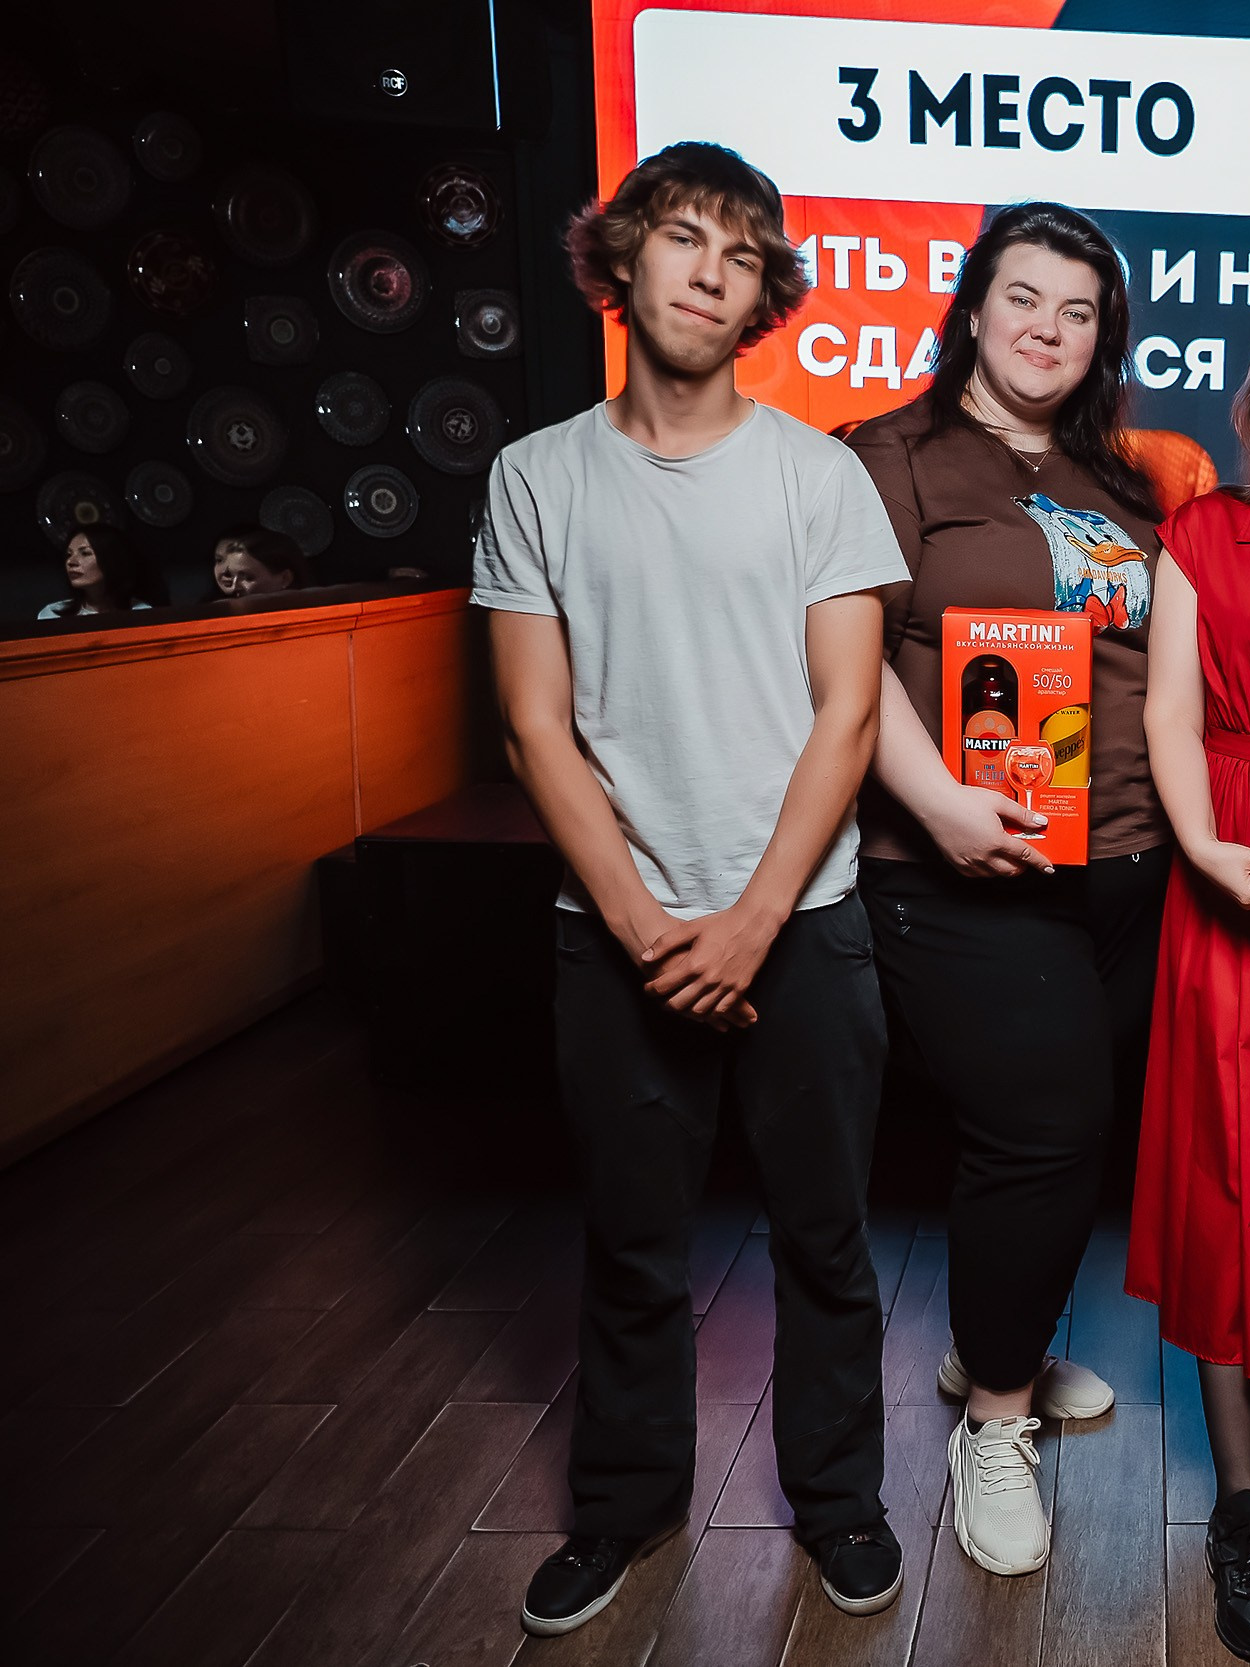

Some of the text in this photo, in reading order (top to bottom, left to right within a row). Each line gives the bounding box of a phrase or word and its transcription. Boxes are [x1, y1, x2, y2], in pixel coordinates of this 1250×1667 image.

[382, 76, 405, 90] RCF
[836, 66, 1195, 157] 3 МЕСТО
[1150, 248, 1196, 303] И
[956, 640, 1075, 651] ВКУС ИТАЛЬЯНСКОЙ ЖИЗНИ
[1033, 673, 1072, 690] 50/50
[965, 737, 1011, 750] MARTIN
